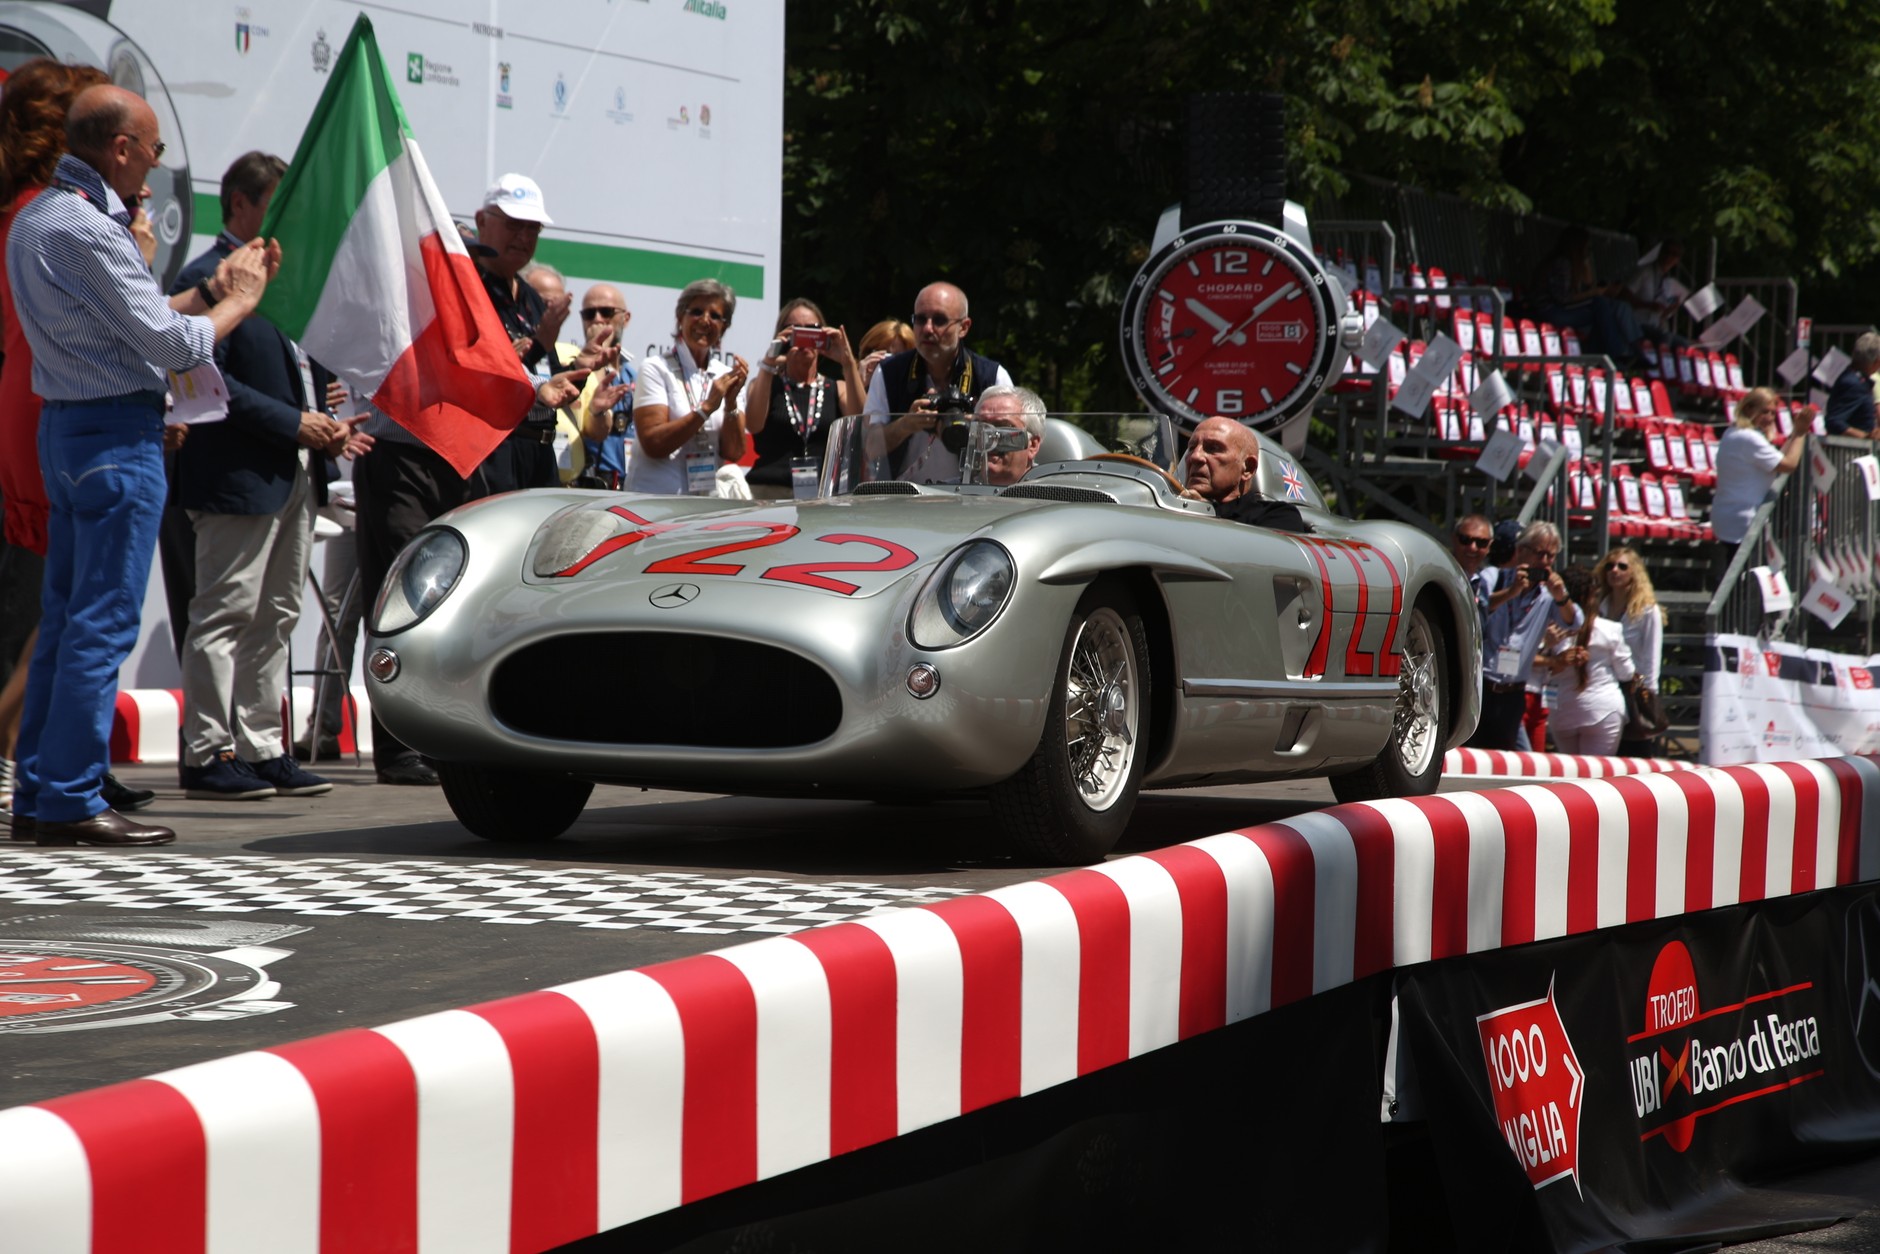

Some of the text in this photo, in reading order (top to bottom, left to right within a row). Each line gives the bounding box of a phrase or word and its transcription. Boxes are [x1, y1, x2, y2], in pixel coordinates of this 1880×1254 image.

[683, 0, 727, 21] Alitalia
[1222, 224, 1237, 234] 60
[1173, 237, 1186, 249] 55
[1273, 236, 1288, 249] 05
[1212, 251, 1249, 274] 12
[1136, 273, 1148, 288] 50
[1312, 273, 1324, 286] 10
[1197, 283, 1264, 293] CHOPARD
[1327, 325, 1336, 337] 15
[1312, 374, 1324, 388] 20
[1216, 389, 1244, 413] 6
[1273, 414, 1286, 425] 25
[553, 505, 919, 597] 722
[1272, 530, 1403, 679] 722
[1650, 985, 1696, 1030] TROFEO
[1489, 1023, 1547, 1092] 1000
[1630, 1051, 1662, 1118] UBI
[1691, 1038, 1747, 1095] Banco
[1748, 1018, 1775, 1074] di
